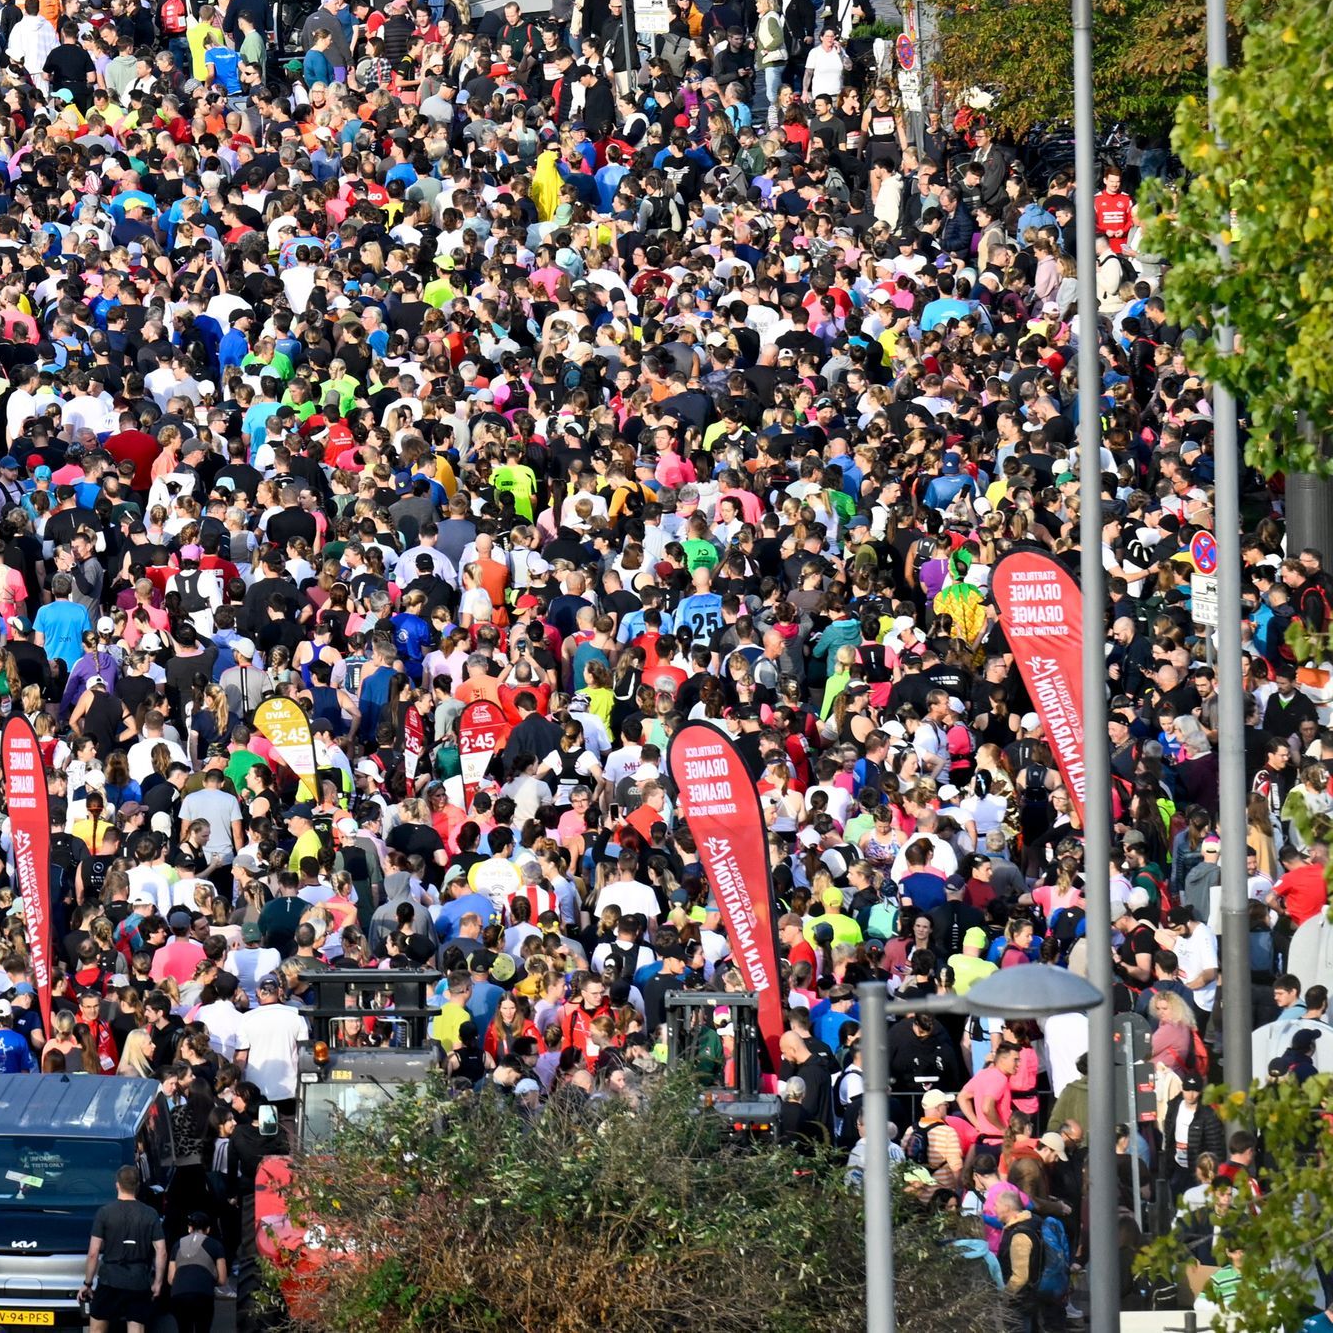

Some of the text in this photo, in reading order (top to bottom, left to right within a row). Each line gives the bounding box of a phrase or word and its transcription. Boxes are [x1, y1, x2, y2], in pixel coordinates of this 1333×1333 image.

[691, 611, 718, 639] 25
[265, 711, 290, 720] DVAG
[271, 726, 310, 745] 2:45
[460, 732, 495, 753] 2:45
[0, 1312, 50, 1323] V-94-PFS
